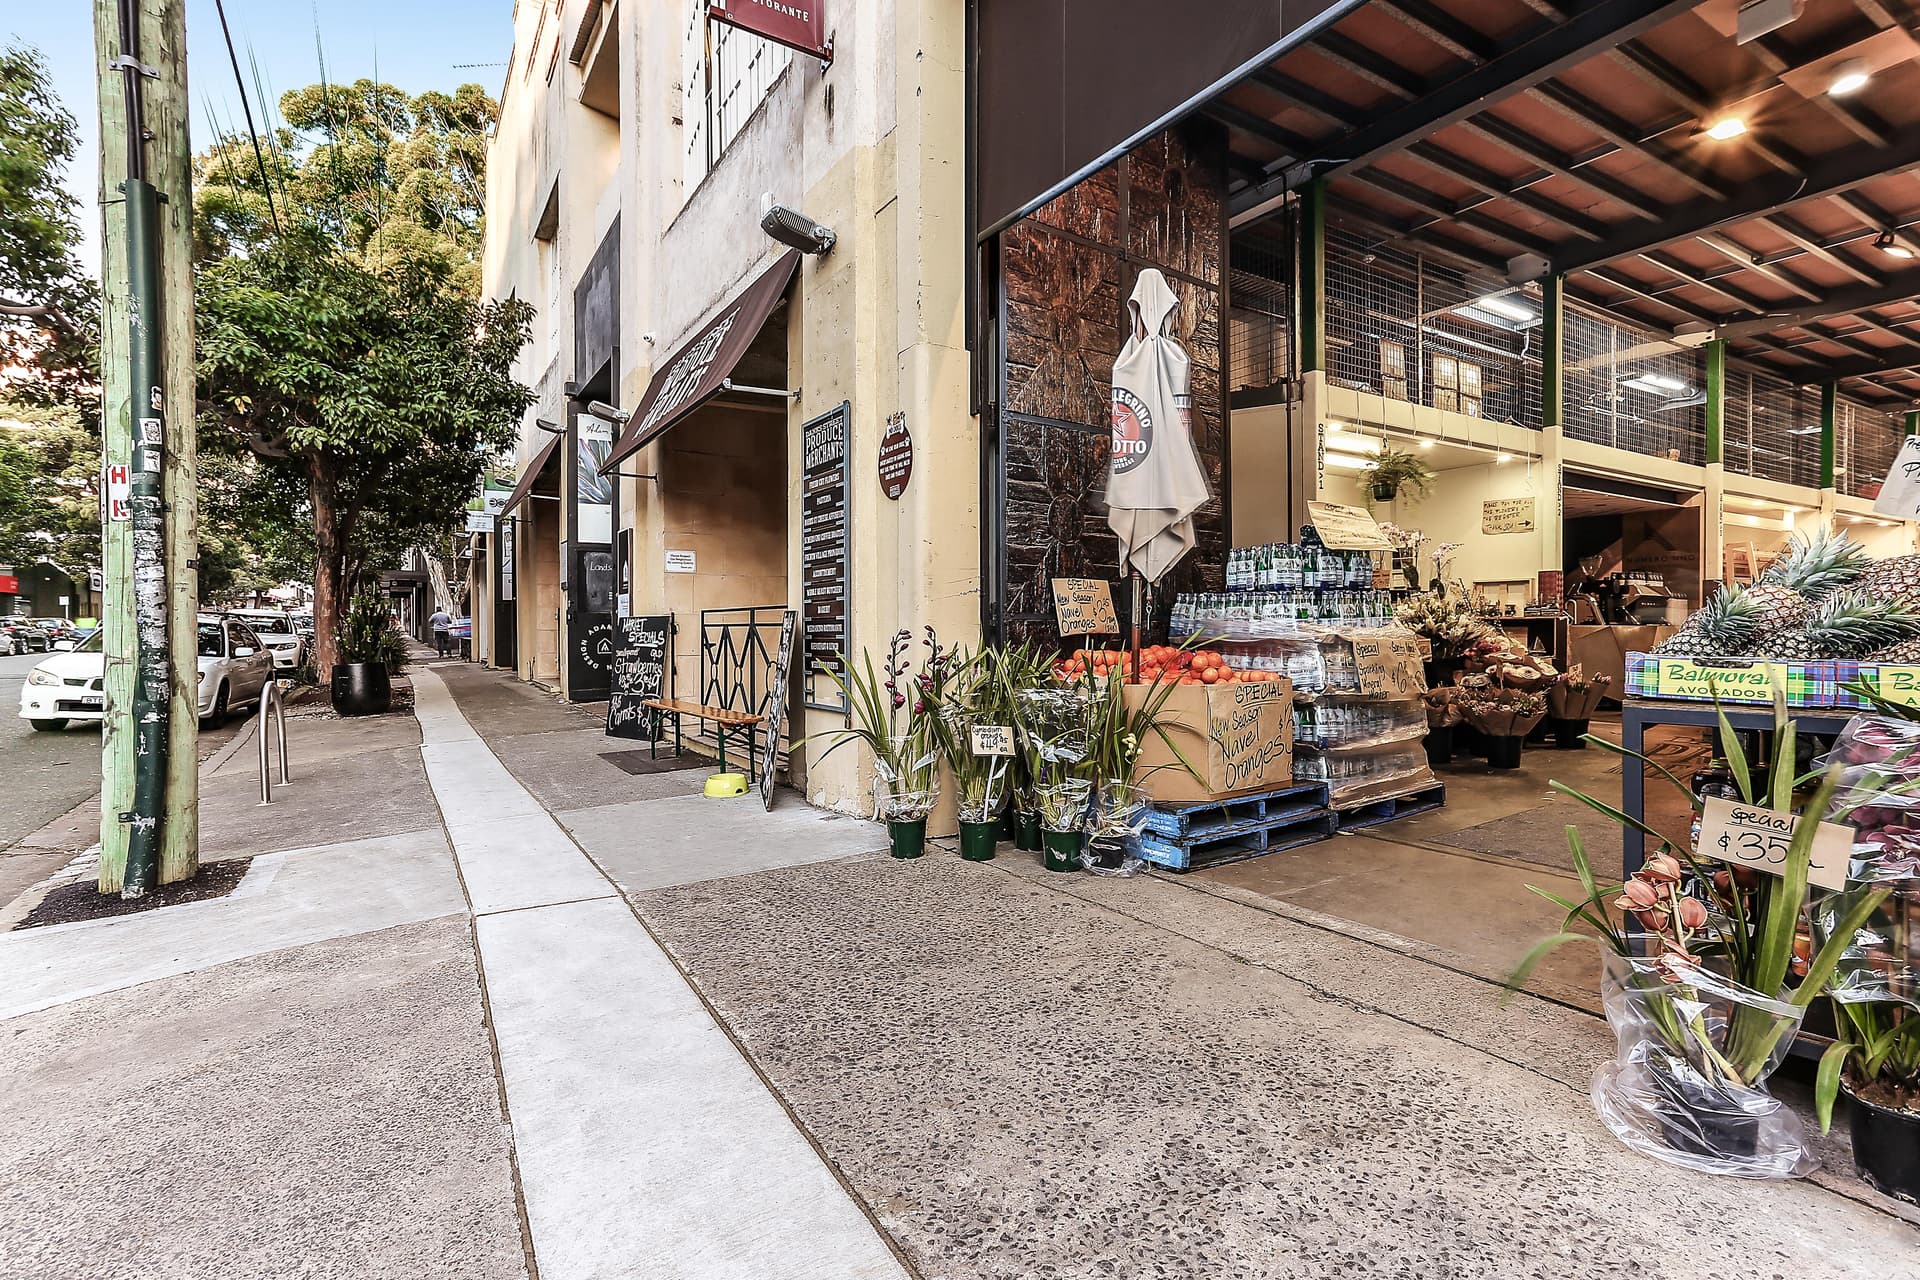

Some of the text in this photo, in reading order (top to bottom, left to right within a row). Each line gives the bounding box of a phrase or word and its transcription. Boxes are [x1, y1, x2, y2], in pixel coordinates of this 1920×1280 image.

[805, 421, 844, 455] PRODUCE
[805, 441, 845, 470] MERCHANTS
[111, 466, 126, 484] H
[1060, 605, 1085, 619] Navel
[1061, 619, 1097, 634] Oranges
[1235, 682, 1283, 704] SPECIAL
[1676, 685, 1767, 699] AVOCADOS
[1231, 706, 1263, 731] Season
[1220, 721, 1260, 764] Navel
[1225, 734, 1285, 790] Oranges
[1717, 830, 1793, 865] $35
